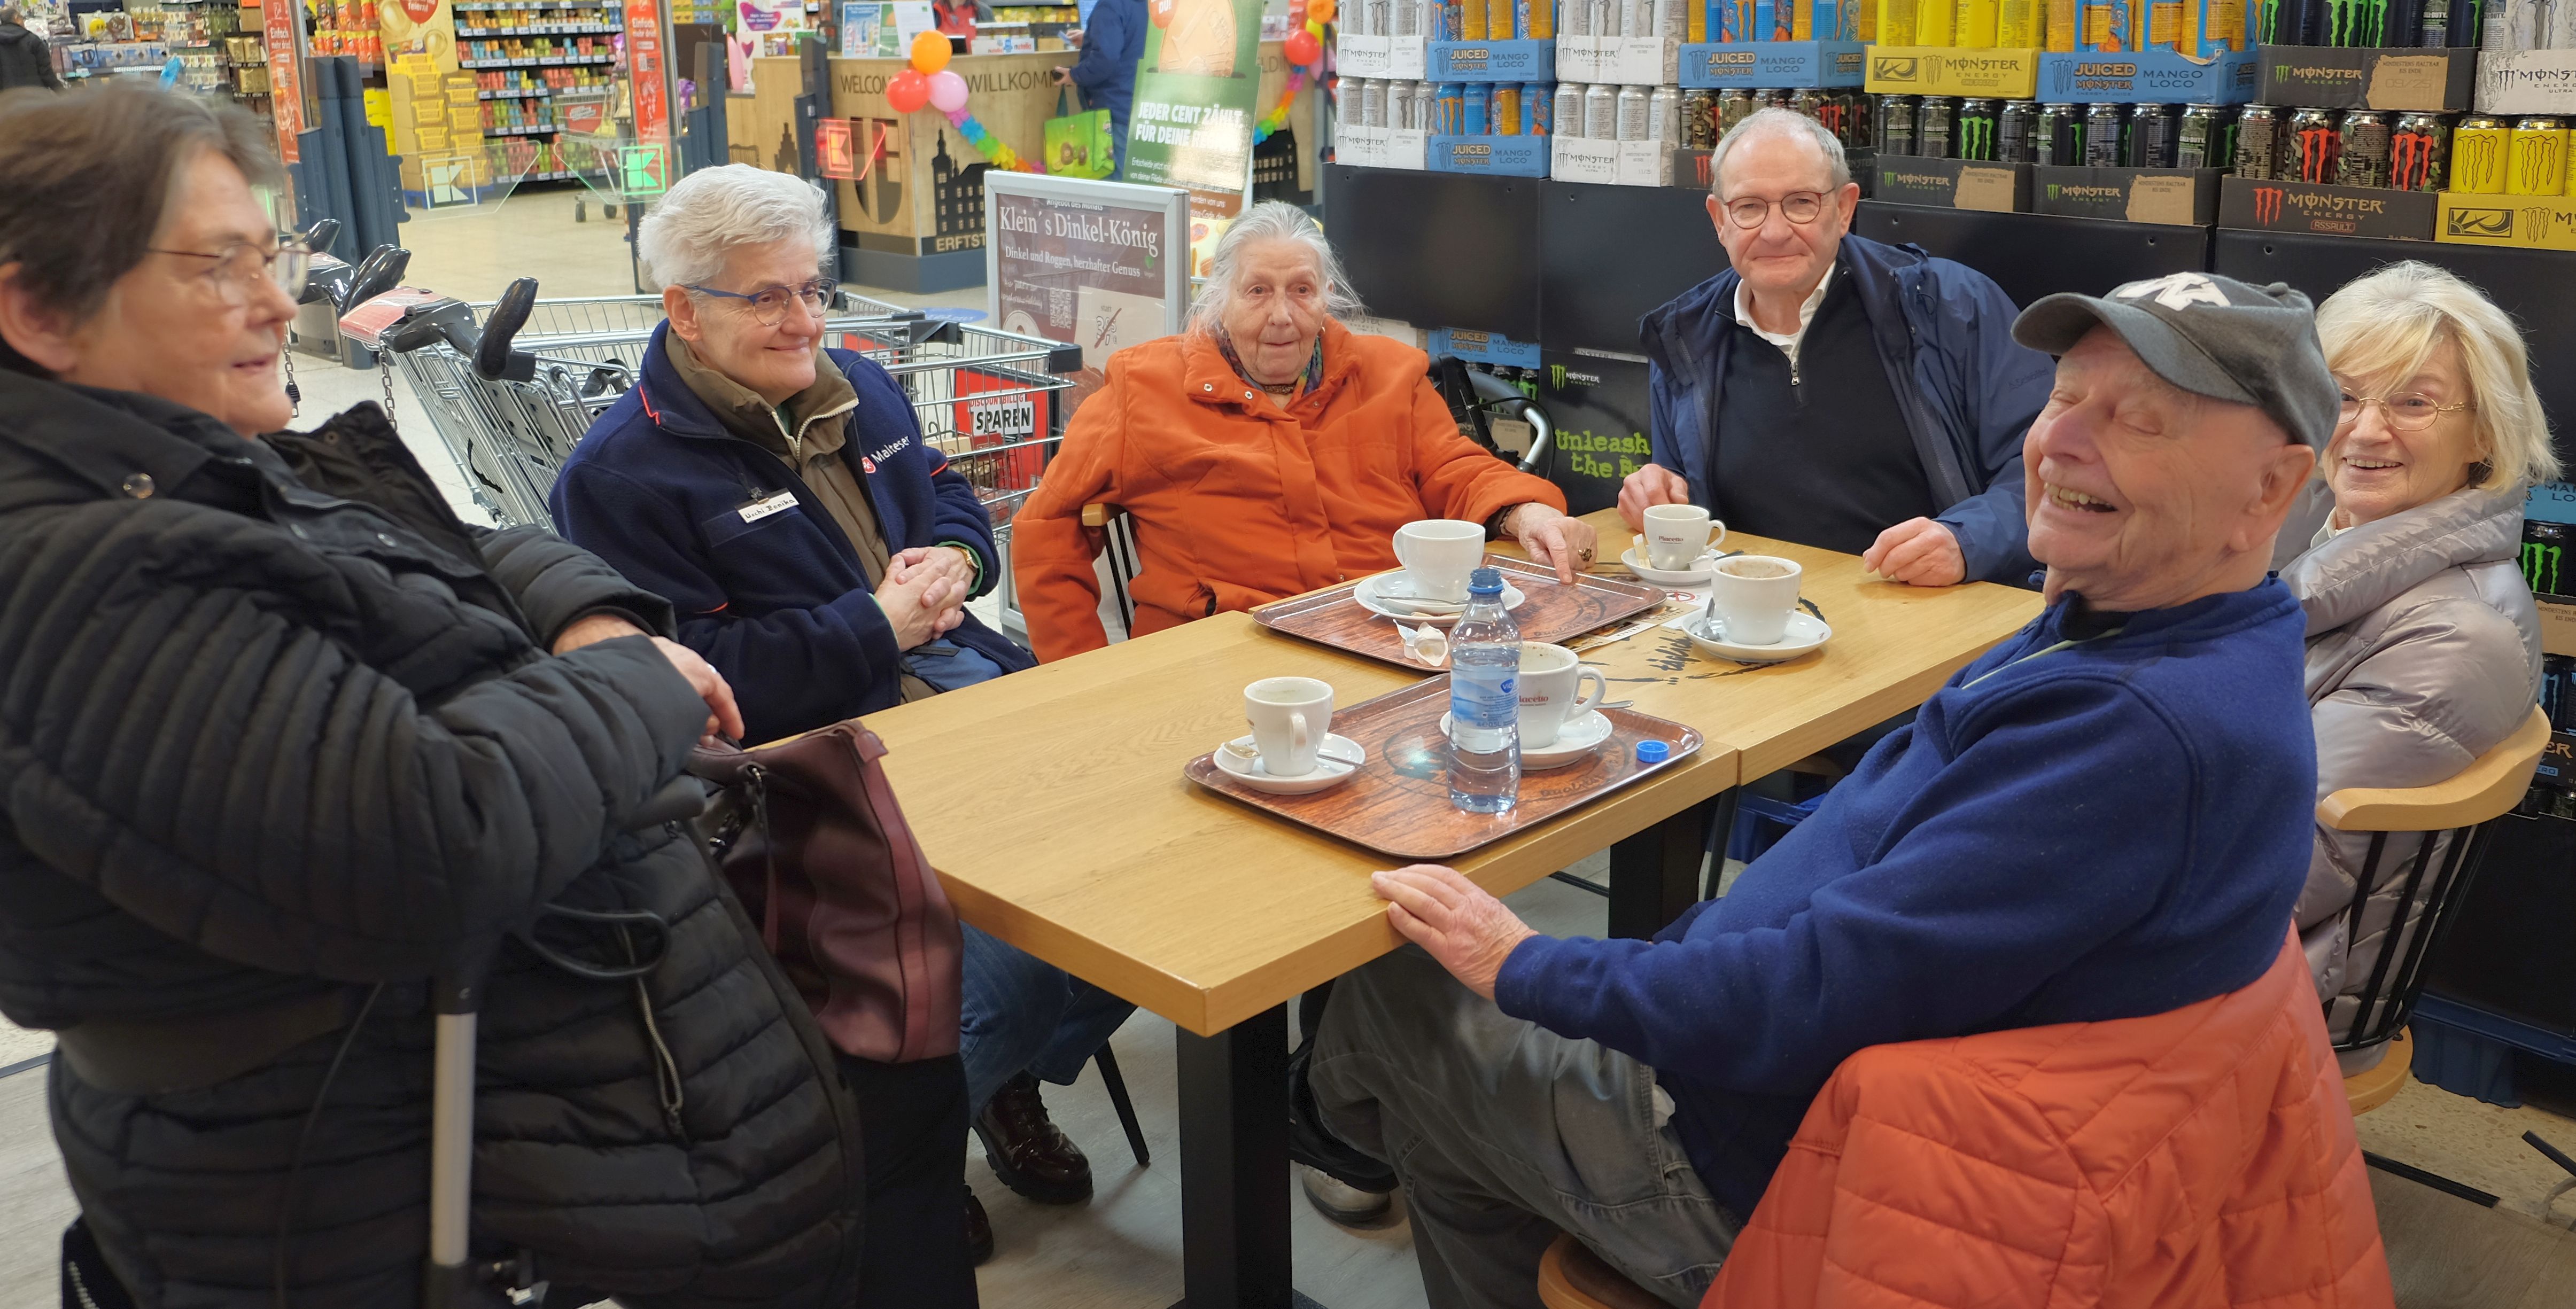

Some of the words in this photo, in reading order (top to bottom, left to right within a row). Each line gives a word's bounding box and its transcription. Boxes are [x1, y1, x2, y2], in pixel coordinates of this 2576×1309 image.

[1450, 49, 1489, 60] JUICED
[1573, 48, 1617, 58] MONSTER
[1707, 52, 1756, 64] JUICED
[1835, 53, 1863, 64] JUICED
[1452, 61, 1488, 71] MONSTER
[1760, 57, 1806, 65] MANGO
[1945, 57, 2020, 71] MONSTER
[1710, 66, 1754, 76] MONSTER
[1766, 65, 1800, 73] LOCO
[2074, 63, 2137, 76] JUICED
[2143, 70, 2203, 79] MANGO
[2293, 66, 2362, 80] MONSTER
[2076, 79, 2133, 90] MONSTER
[1138, 102, 1170, 121] JEDER
[1171, 105, 1201, 124] CENT
[1135, 120, 1157, 143] FÜR
[1157, 126, 1191, 146] DEINE
[1452, 144, 1491, 155] JUICED
[1570, 153, 1615, 164] MONSTER
[1897, 173, 1950, 186] MONSTER
[2062, 185, 2121, 198] MONSTER
[1207, 198, 1215, 206] von
[1216, 199, 1225, 208] uns
[2287, 192, 2384, 214] MONSTER
[2303, 210, 2365, 221] ENERGY
[1054, 213, 1159, 258] Dinkel-König
[1005, 246, 1029, 261] Dinkel
[1030, 251, 1043, 263] und
[1044, 252, 1073, 269] Roggen,
[1074, 255, 1111, 274] herzhafter
[1112, 261, 1140, 277] Genuss
[1100, 304, 1112, 313] statt
[1450, 330, 1489, 343] JUICED
[1493, 339, 1529, 348] MANGO
[1497, 347, 1525, 355] LOCO
[1566, 372, 1600, 383] MONSTER
[976, 407, 1031, 431] SPAREN
[1555, 428, 1651, 456] Unleash
[870, 435, 911, 464] Malteser
[1571, 452, 1613, 478] the
